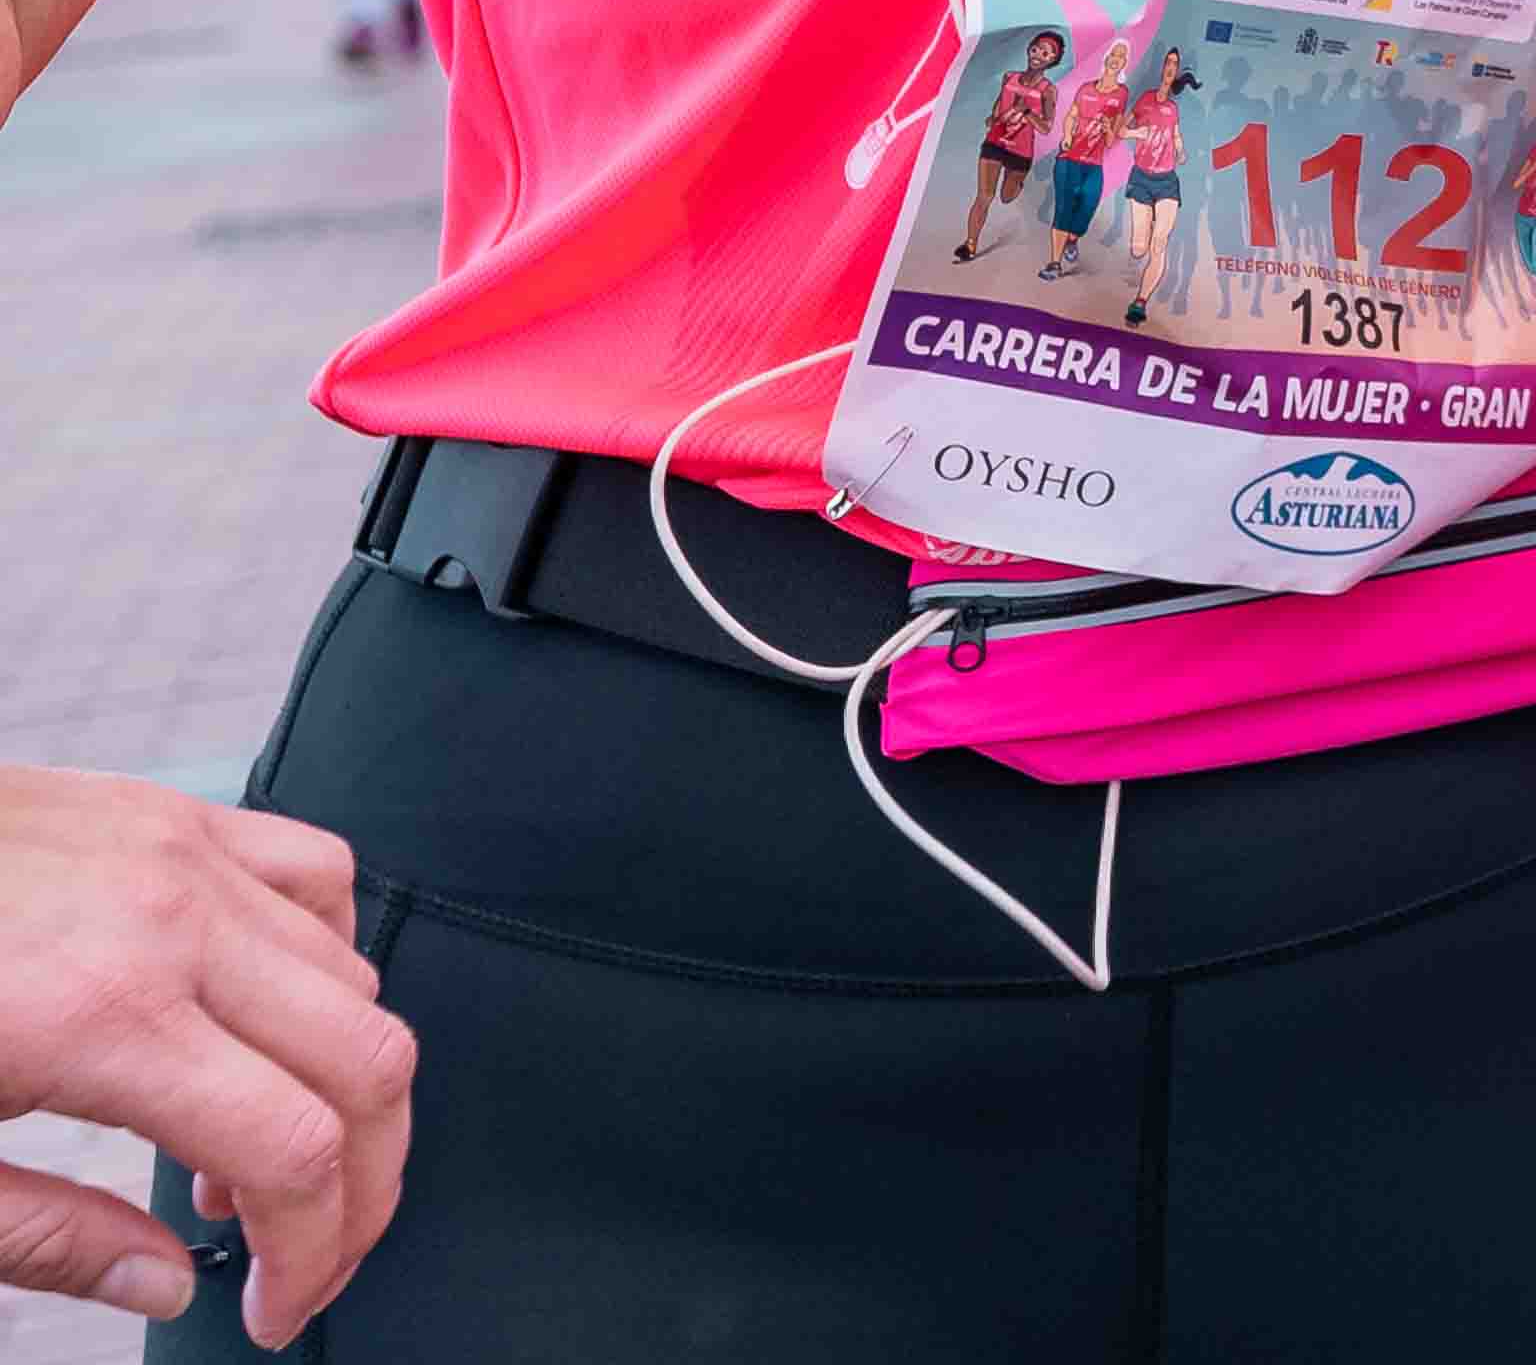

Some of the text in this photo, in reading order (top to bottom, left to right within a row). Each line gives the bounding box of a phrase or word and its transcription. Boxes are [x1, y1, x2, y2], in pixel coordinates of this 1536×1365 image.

[1213, 122, 1474, 272] 112
[1304, 265, 1375, 288] VIOLENCIA
[1379, 277, 1397, 292] DE
[1291, 289, 1404, 352] 1387
[904, 315, 1121, 390] CARRERA
[1137, 355, 1199, 406] DE
[1213, 373, 1270, 419] LA
[1283, 375, 1406, 426] MUJER
[1440, 385, 1530, 430] GRAN
[934, 444, 1117, 509] OYSHO
[1285, 485, 1341, 499] CENTRAL
[1245, 495, 1400, 533] ASTURIANA
